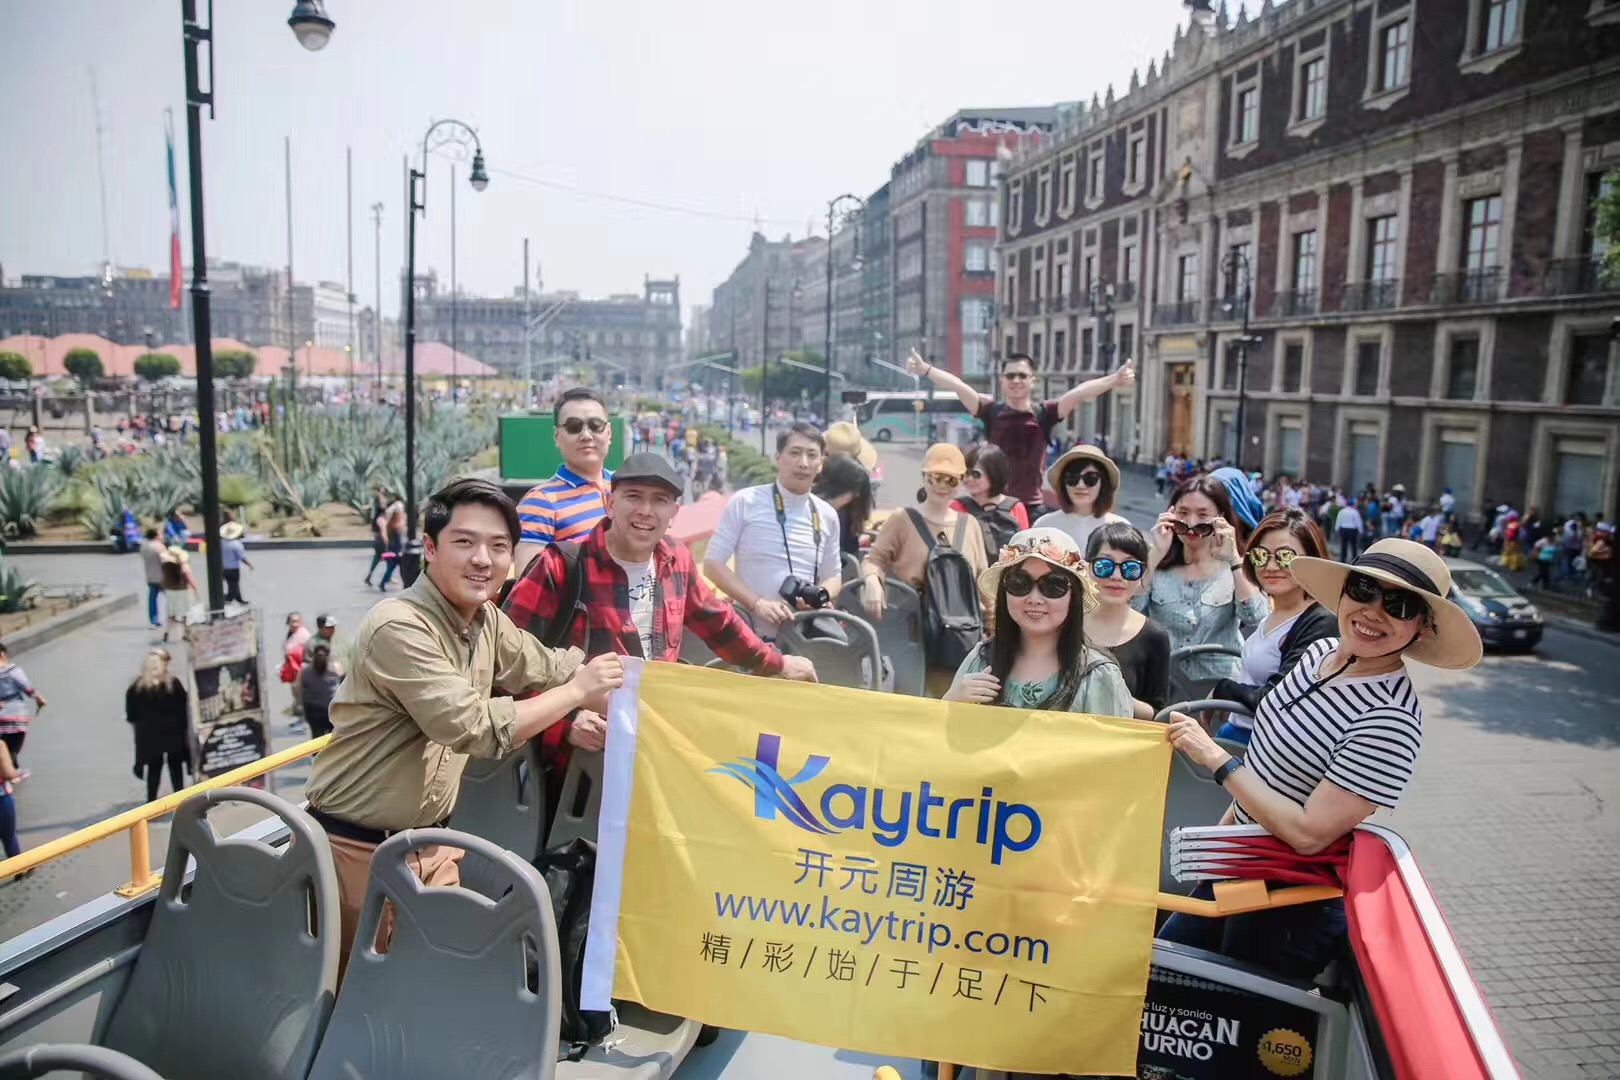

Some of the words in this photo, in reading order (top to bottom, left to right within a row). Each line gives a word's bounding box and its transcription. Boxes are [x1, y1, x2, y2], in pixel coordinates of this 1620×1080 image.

[704, 732, 1042, 866] Kaytrip
[794, 848, 976, 911] 开元周游
[714, 891, 1050, 965] www.kaytrip.com
[1151, 1002, 1168, 1013] luz
[1169, 1007, 1176, 1016] y
[1177, 1008, 1213, 1021] sonido
[1140, 1031, 1213, 1061] URNO
